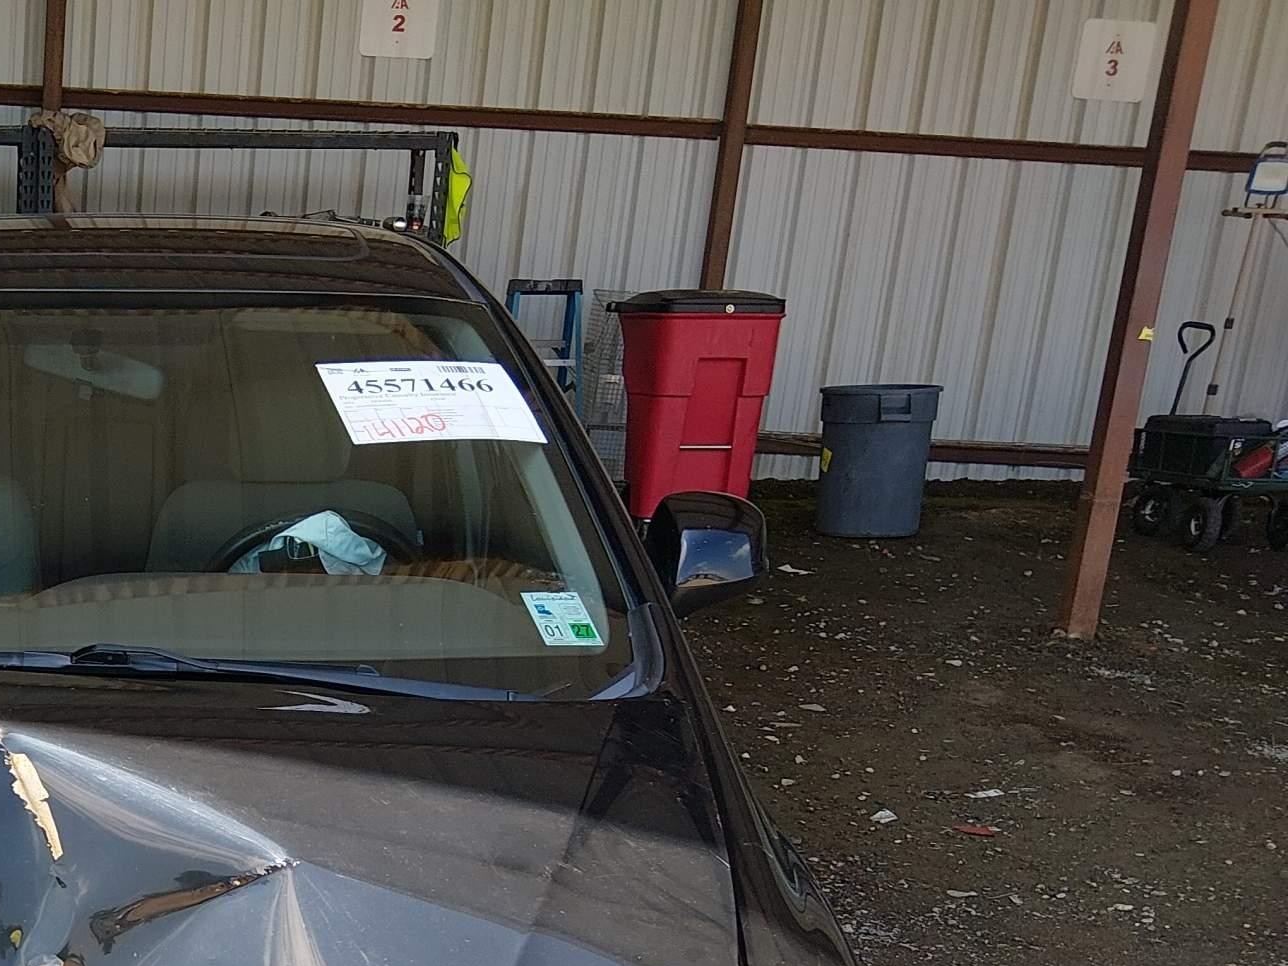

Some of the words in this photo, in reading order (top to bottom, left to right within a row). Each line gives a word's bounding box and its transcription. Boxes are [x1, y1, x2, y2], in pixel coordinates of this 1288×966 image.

[392, 14, 406, 32] 2
[1105, 59, 1118, 76] 3
[346, 376, 494, 394] 45571466
[544, 624, 563, 638] 01
[573, 624, 591, 637] 27
